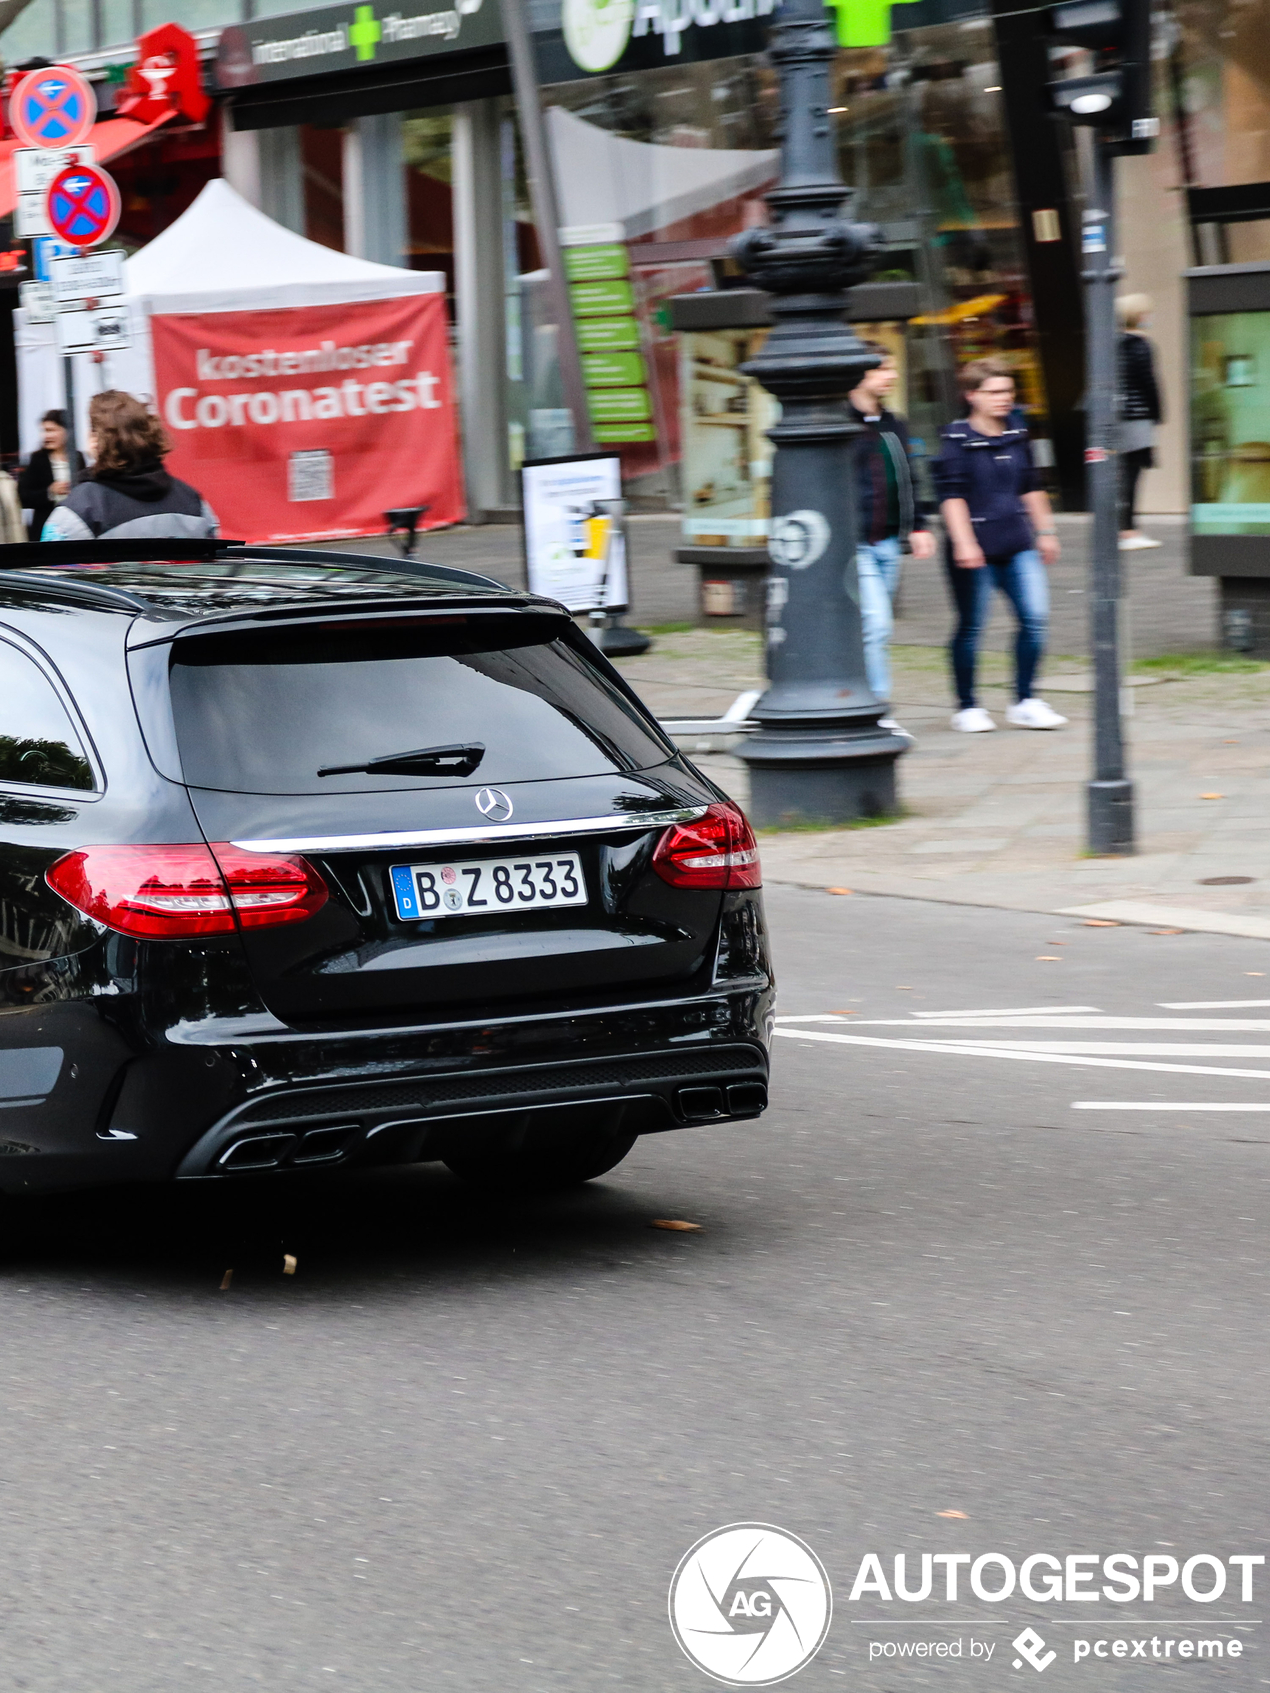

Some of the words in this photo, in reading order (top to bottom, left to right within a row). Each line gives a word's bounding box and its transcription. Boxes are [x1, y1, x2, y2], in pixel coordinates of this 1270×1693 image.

[195, 339, 415, 381] kostenloser
[165, 370, 443, 430] Coronatest
[402, 897, 412, 909] D
[415, 872, 441, 911] B
[461, 867, 488, 907] Z
[492, 859, 579, 904] 8333
